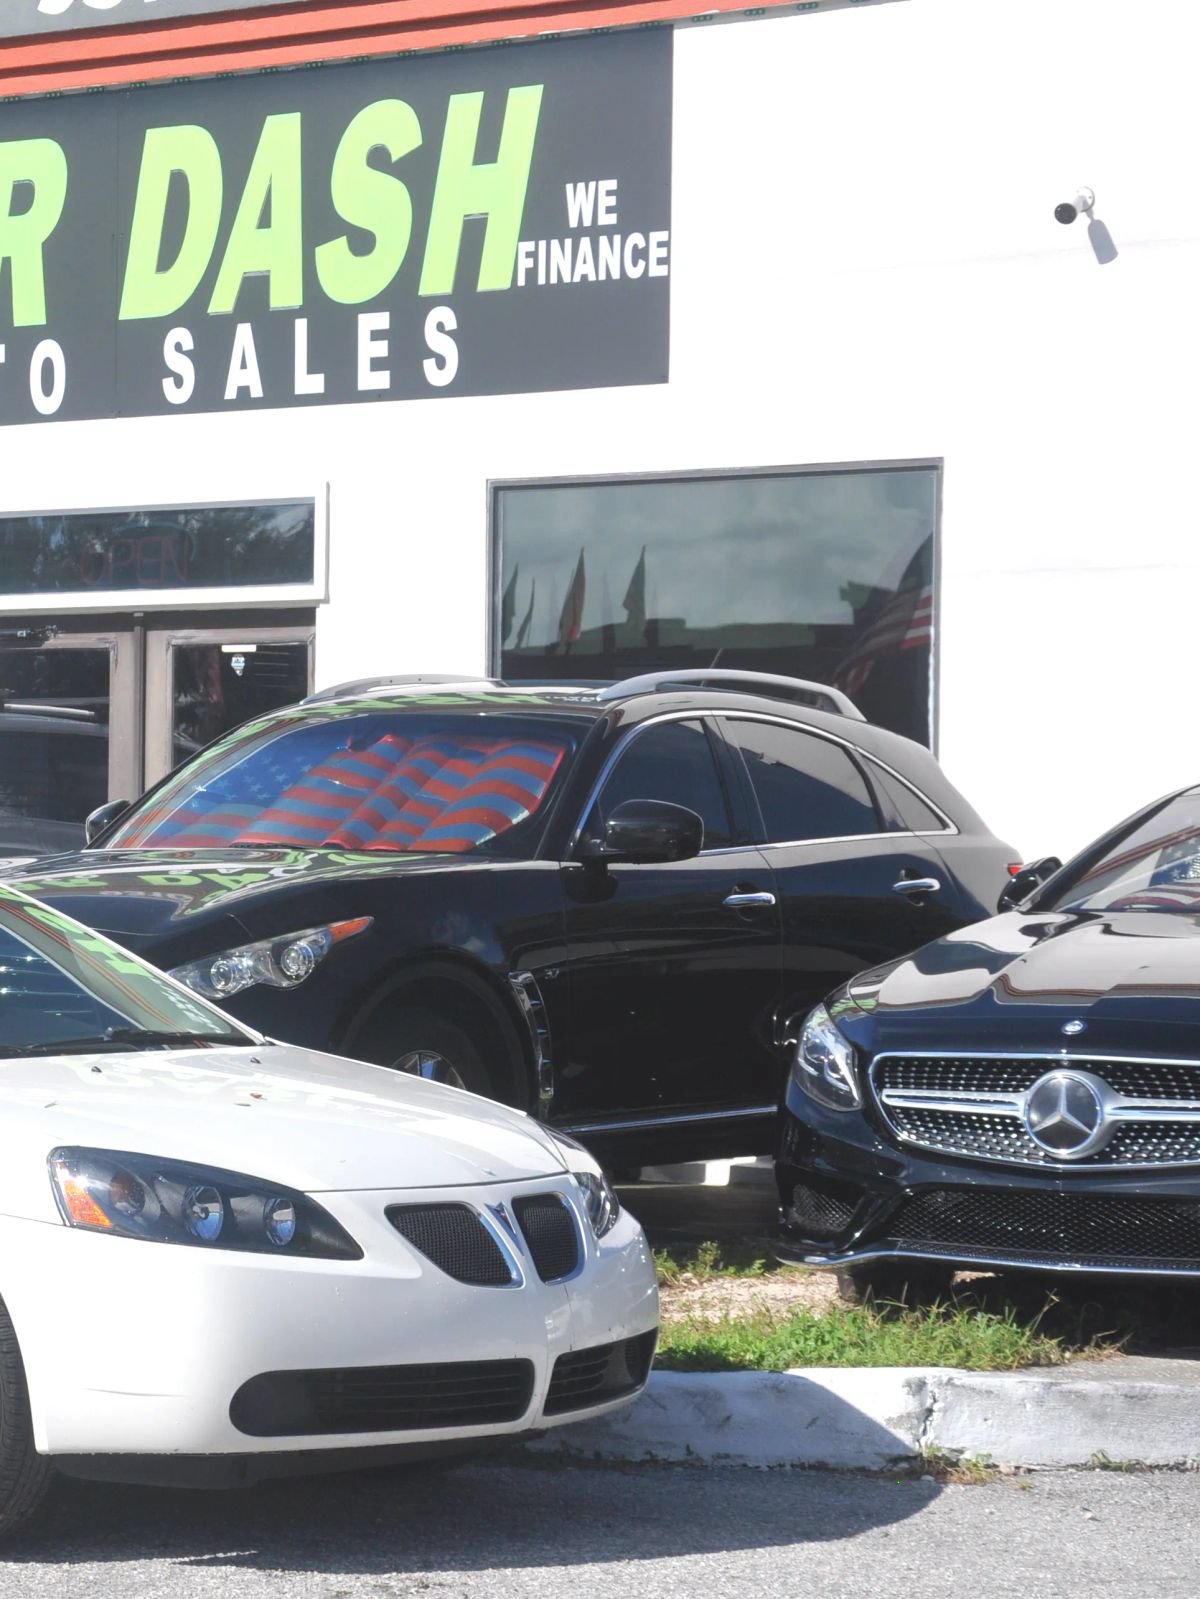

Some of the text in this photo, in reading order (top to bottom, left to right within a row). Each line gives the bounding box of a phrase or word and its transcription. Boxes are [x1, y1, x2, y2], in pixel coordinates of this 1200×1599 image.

[118, 83, 544, 321] DASH
[565, 178, 618, 229] WE
[516, 230, 670, 287] FINANCE
[161, 305, 460, 405] SALES
[80, 535, 189, 584] OPEN
